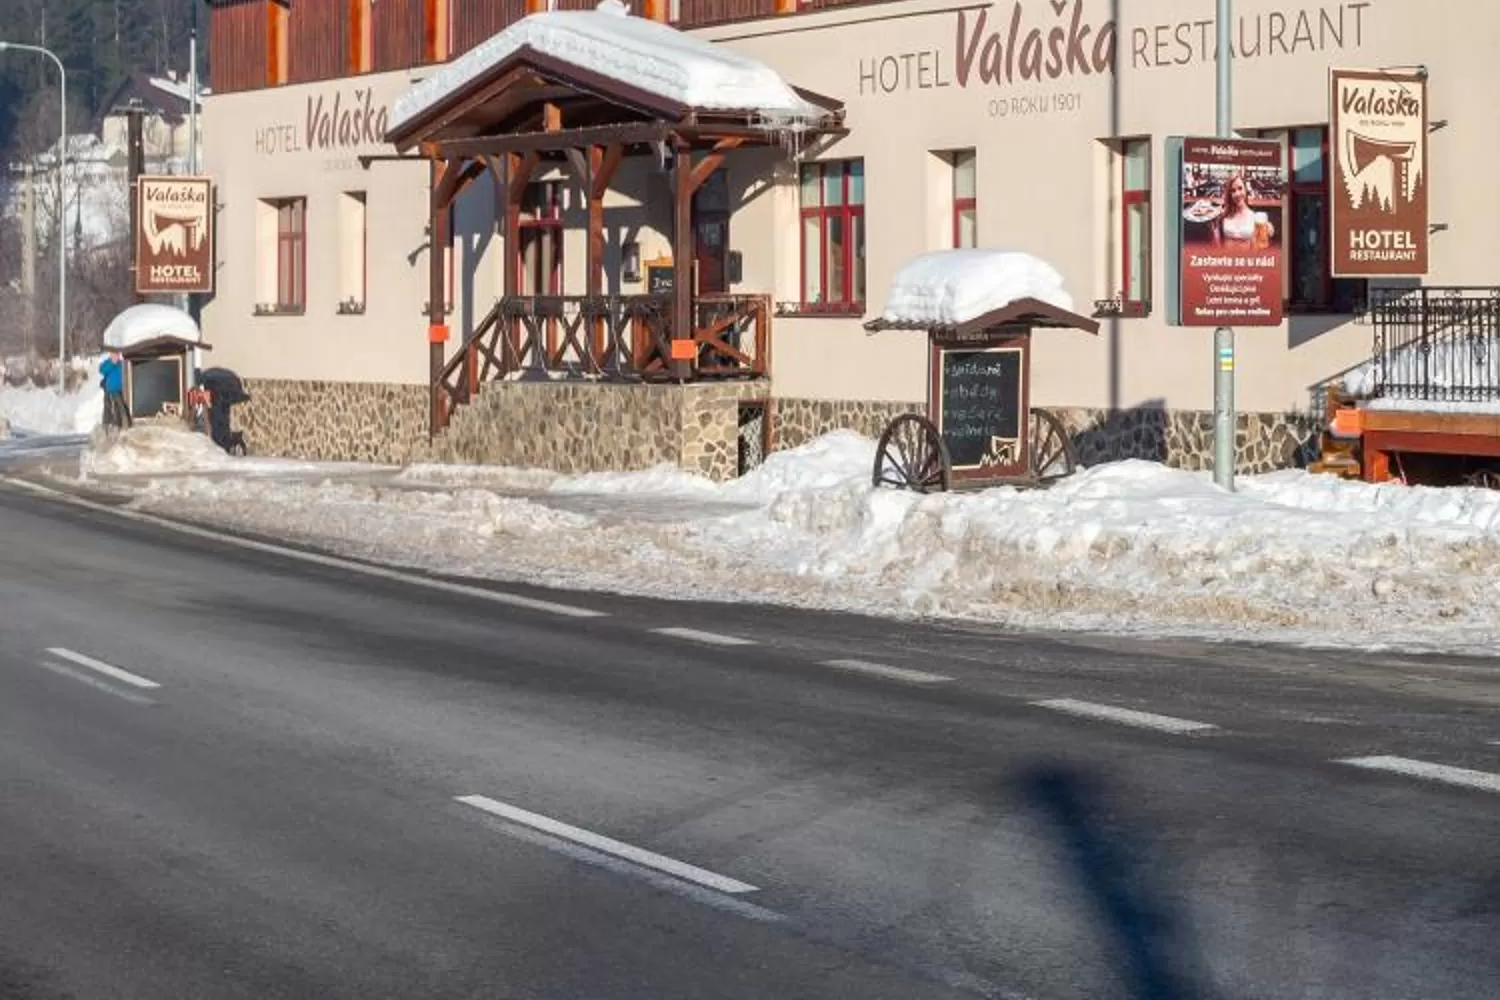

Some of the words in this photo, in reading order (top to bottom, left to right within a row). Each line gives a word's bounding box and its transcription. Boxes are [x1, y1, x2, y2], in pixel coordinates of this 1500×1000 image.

[859, 50, 950, 95] HOTEL
[1342, 85, 1419, 118] Valaška
[255, 124, 301, 155] HOTEL
[306, 87, 389, 152] Valaška
[146, 186, 205, 204] Valaška
[1349, 229, 1416, 249] HOTEL
[1349, 249, 1416, 261] RESTAURANT
[151, 265, 201, 277] HOTEL
